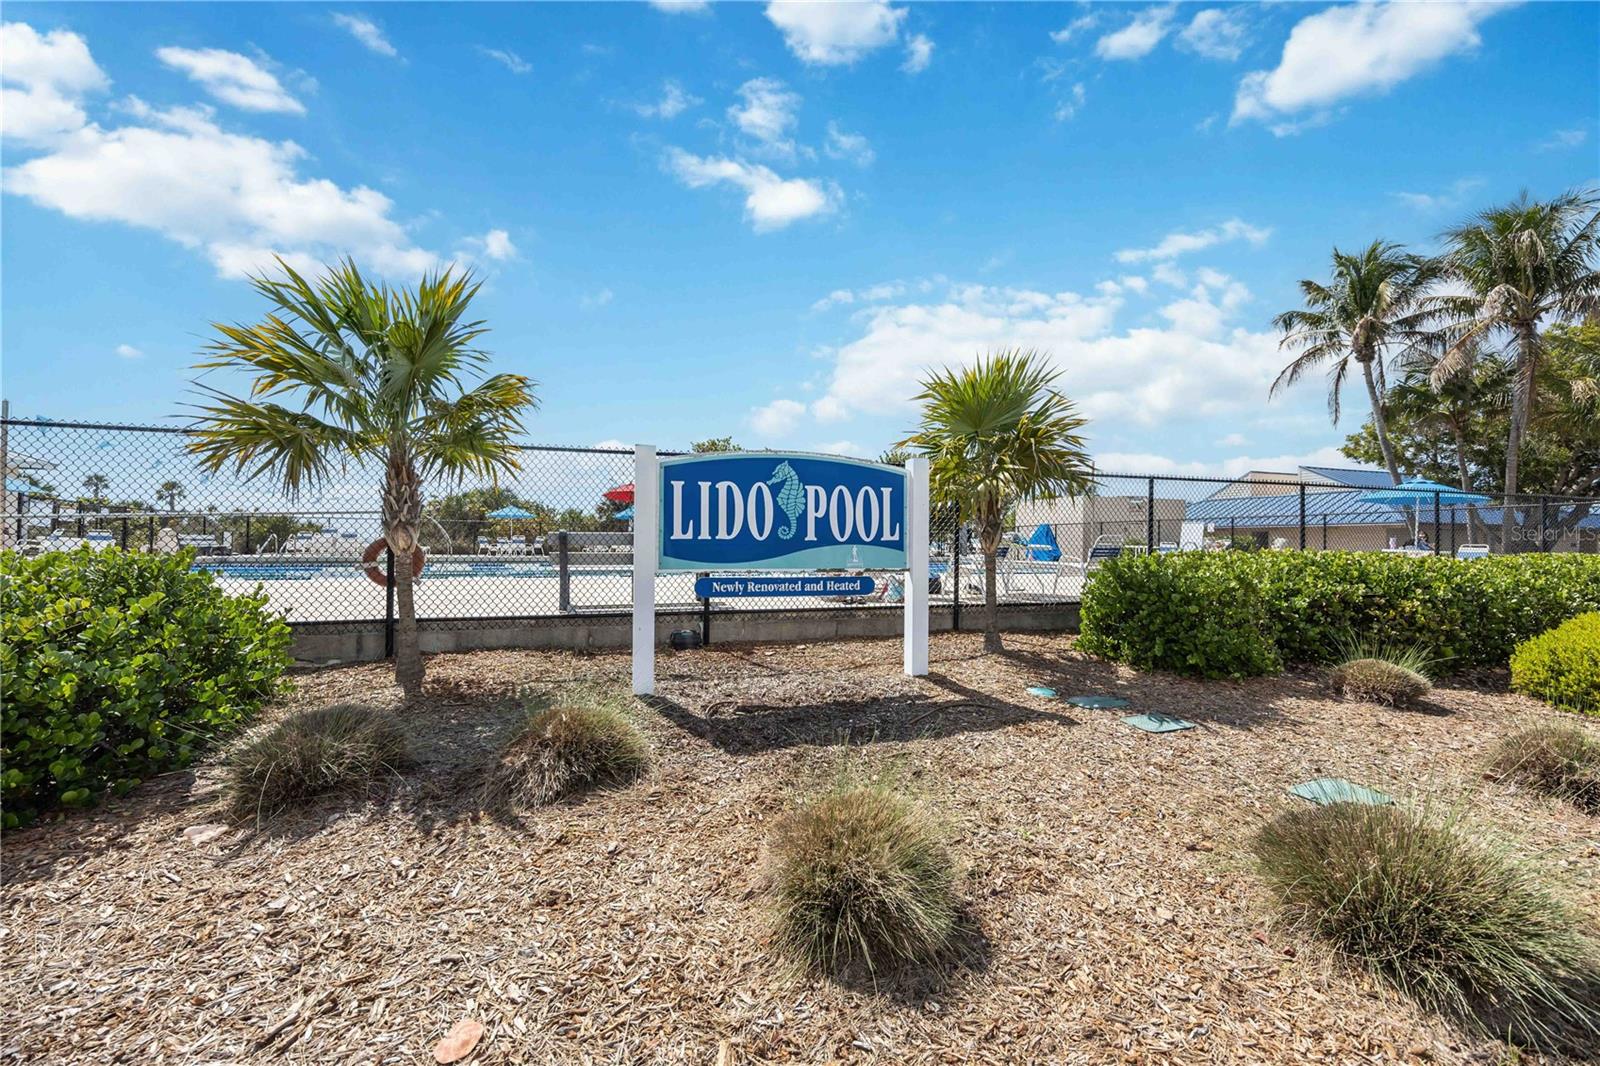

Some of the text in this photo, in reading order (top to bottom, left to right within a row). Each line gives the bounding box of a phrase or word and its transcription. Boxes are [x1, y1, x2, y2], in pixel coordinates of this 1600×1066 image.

[670, 480, 900, 543] LIDO POOL
[712, 580, 861, 595] Newly Renovated and Heated
